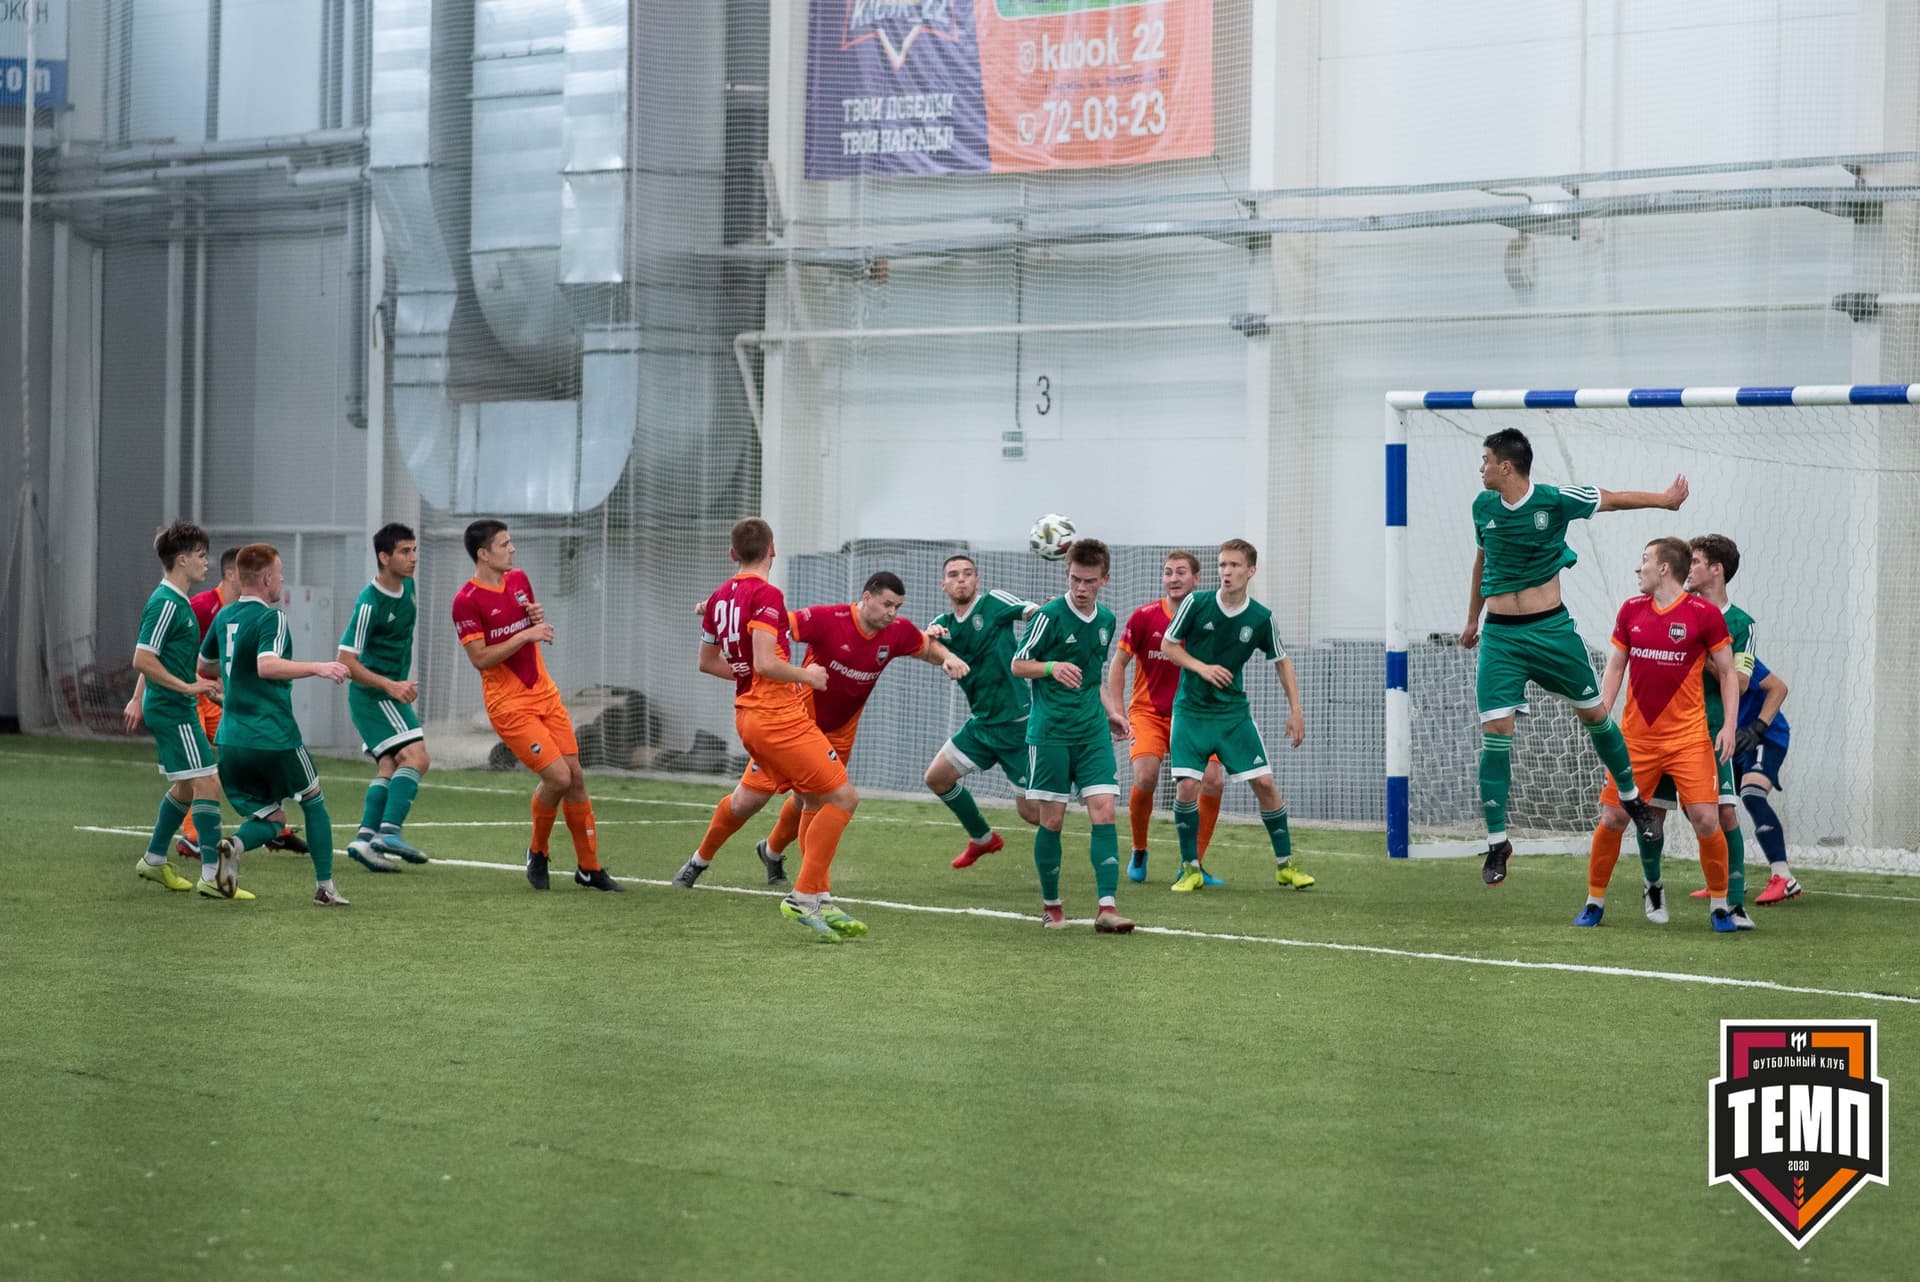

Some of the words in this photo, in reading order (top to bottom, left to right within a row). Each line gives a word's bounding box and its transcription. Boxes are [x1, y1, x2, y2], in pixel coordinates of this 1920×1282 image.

[1042, 91, 1166, 144] 72-03-23
[1036, 375, 1051, 416] 3
[1756, 744, 1764, 763] 1
